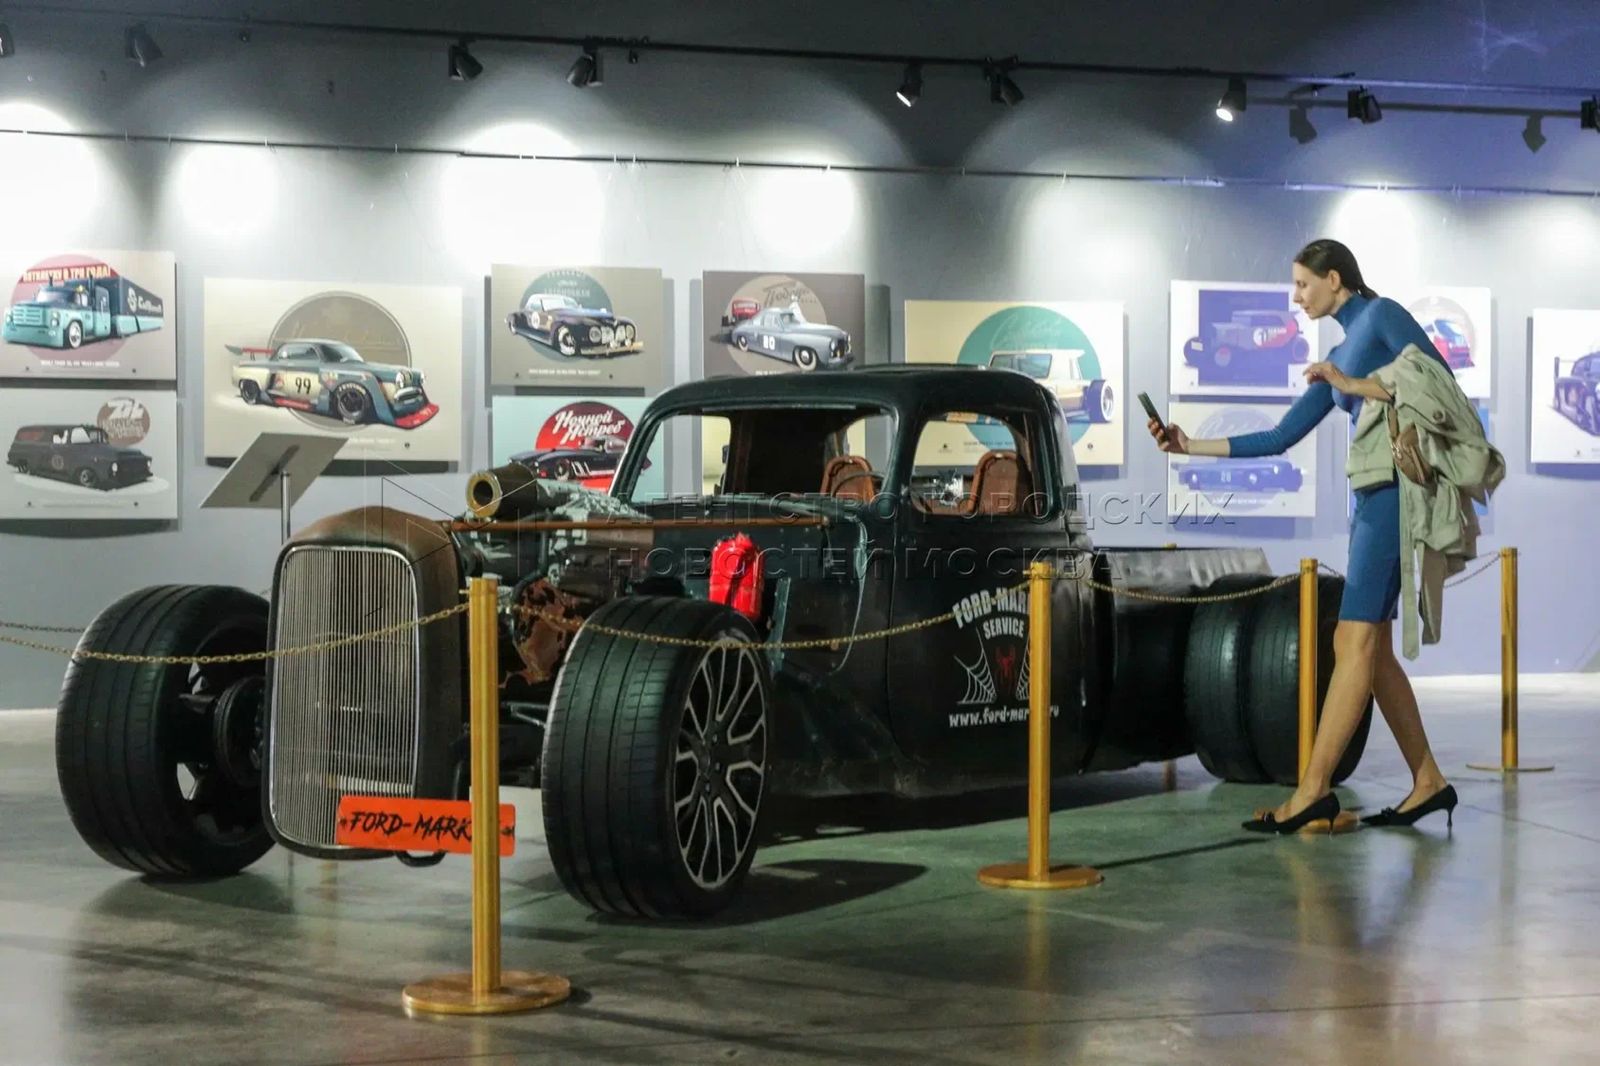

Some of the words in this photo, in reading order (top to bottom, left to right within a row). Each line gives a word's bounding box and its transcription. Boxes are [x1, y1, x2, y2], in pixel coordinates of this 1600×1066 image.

[295, 376, 311, 395] 99
[553, 410, 614, 433] Ночной
[560, 420, 626, 444] Ястреб
[983, 616, 1025, 640] SERVICE
[348, 811, 472, 843] FORD-MARK
